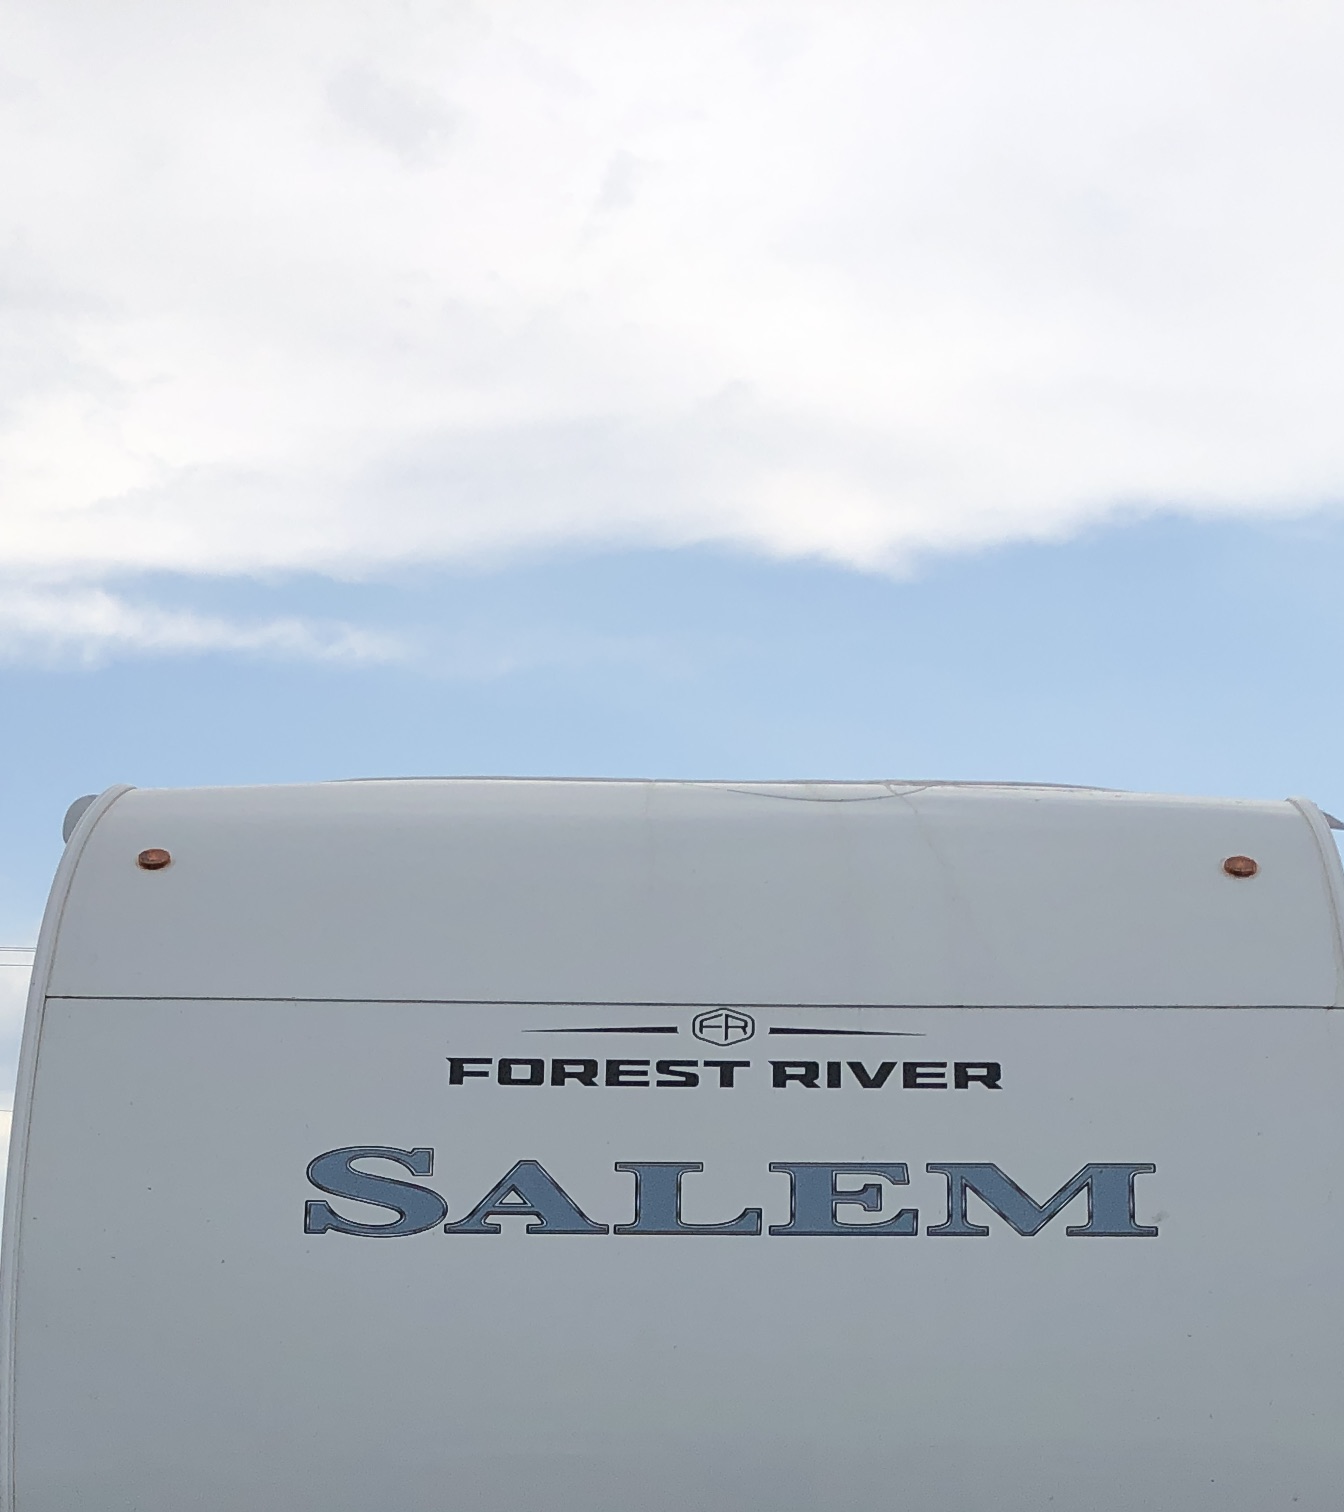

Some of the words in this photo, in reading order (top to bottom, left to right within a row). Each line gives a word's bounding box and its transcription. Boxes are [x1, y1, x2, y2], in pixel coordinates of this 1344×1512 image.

[446, 1057, 750, 1089] FOREST
[768, 1060, 1003, 1090] RIVER
[304, 1146, 1158, 1238] SALEM
